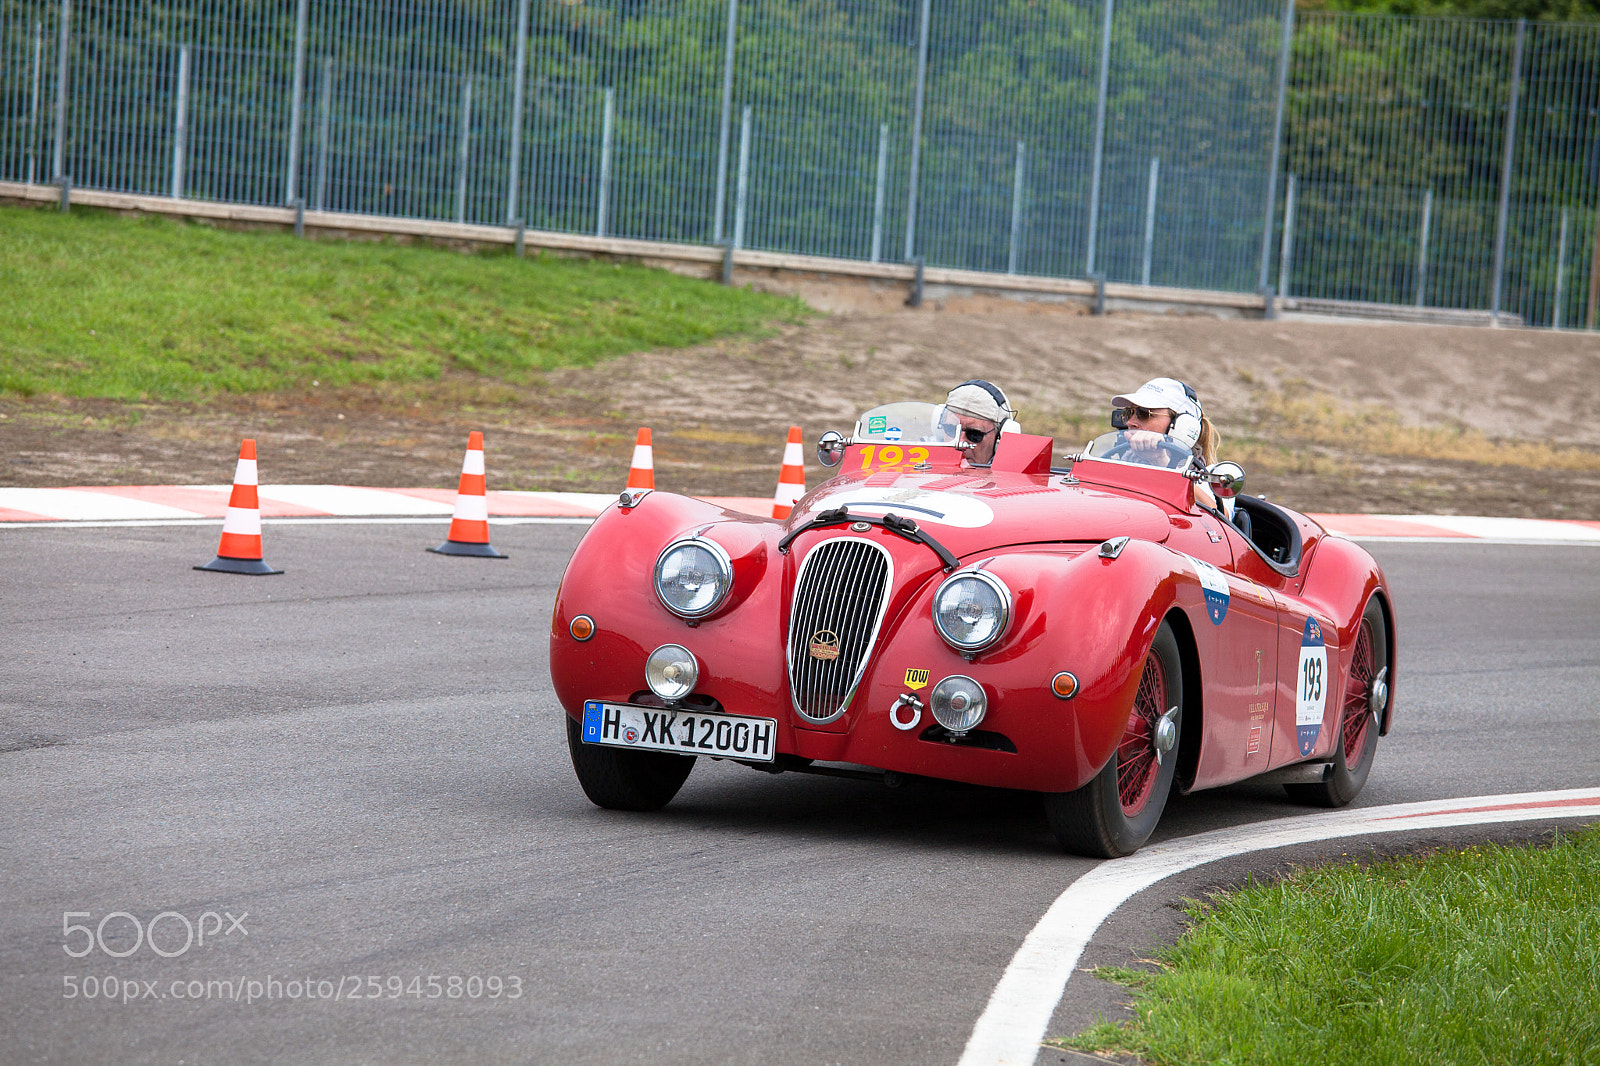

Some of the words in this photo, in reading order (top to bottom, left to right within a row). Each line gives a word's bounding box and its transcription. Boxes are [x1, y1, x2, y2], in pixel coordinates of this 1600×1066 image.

[860, 445, 930, 469] 193
[906, 669, 929, 683] TOW
[1303, 657, 1322, 702] 193
[602, 708, 621, 740] H
